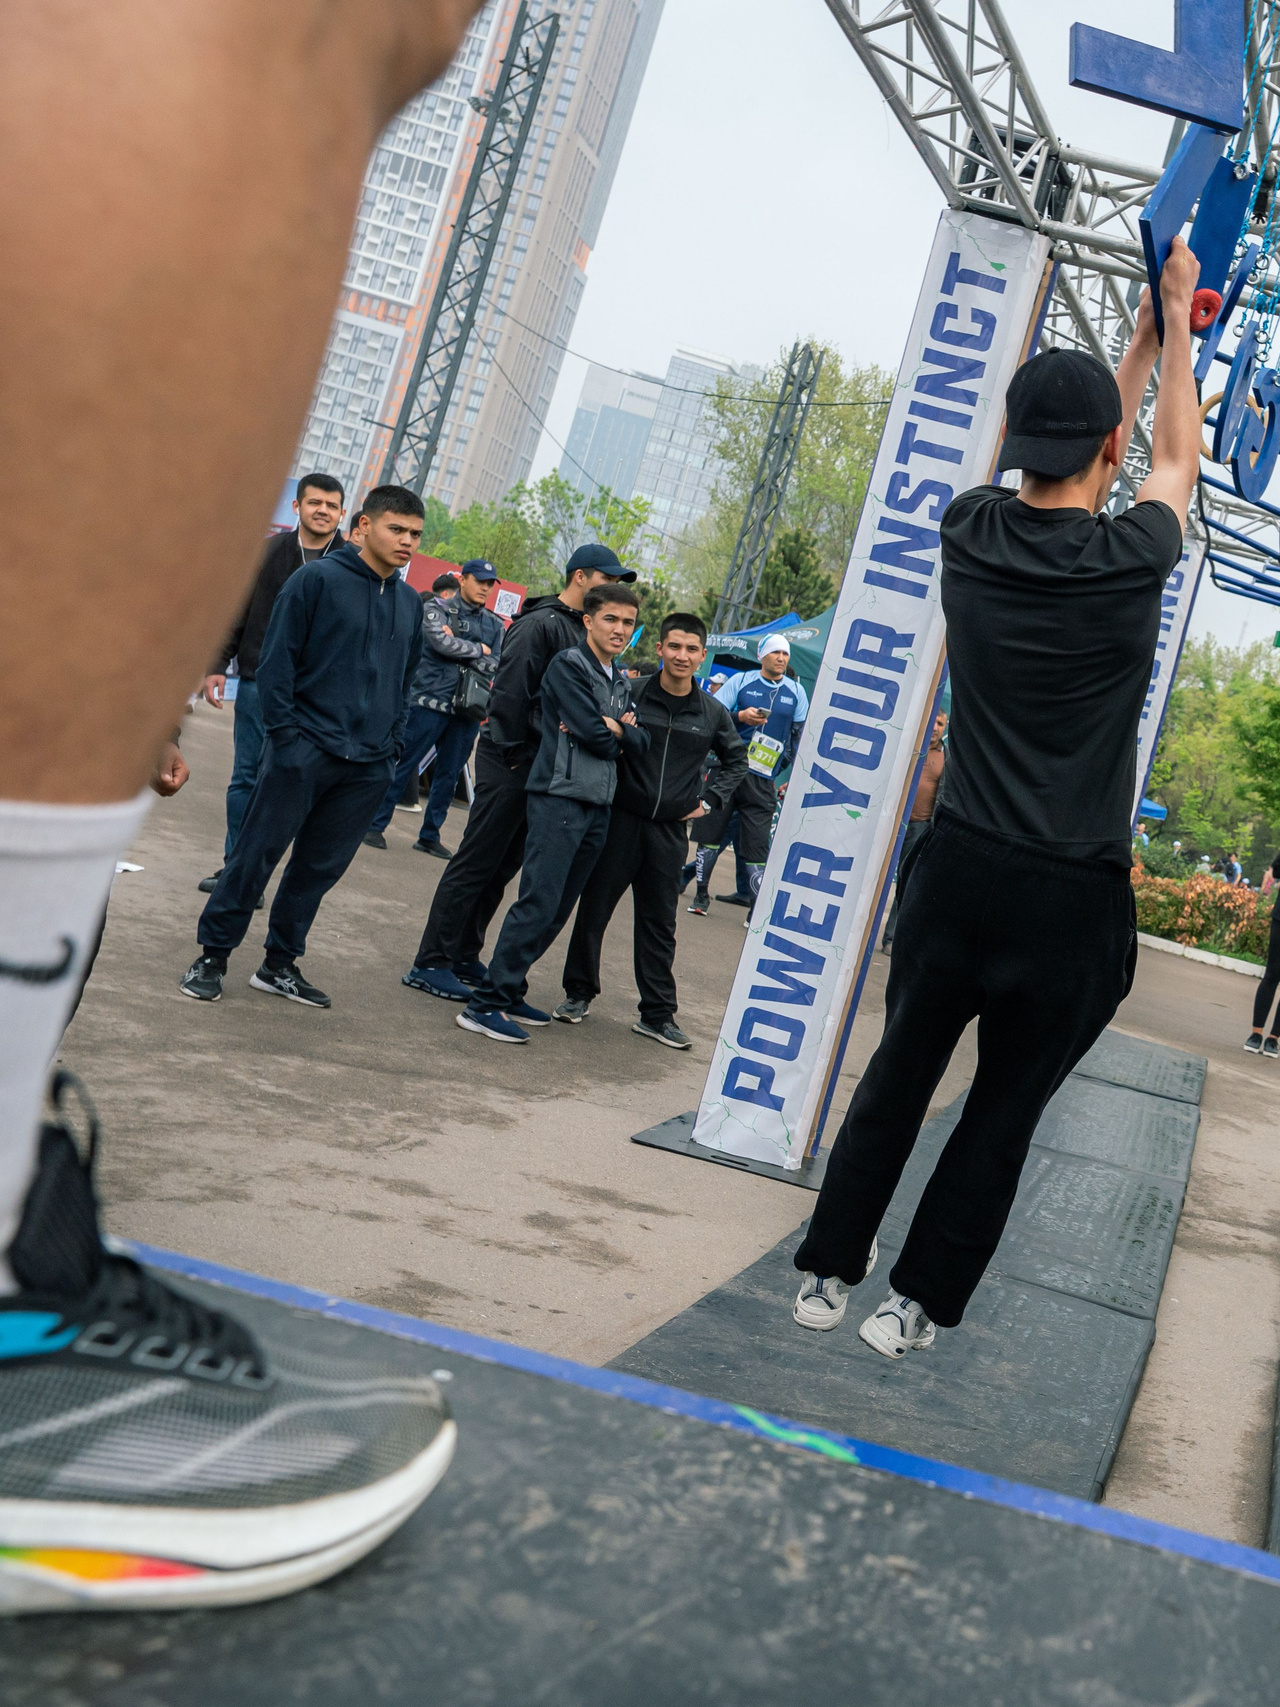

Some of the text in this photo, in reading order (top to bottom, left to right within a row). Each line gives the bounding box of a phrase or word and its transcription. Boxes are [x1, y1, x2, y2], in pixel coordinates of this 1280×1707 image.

[721, 252, 1006, 1112] POWER YOUR INSTINCT
[756, 749, 777, 765] 3711
[695, 851, 705, 882] VENUM
